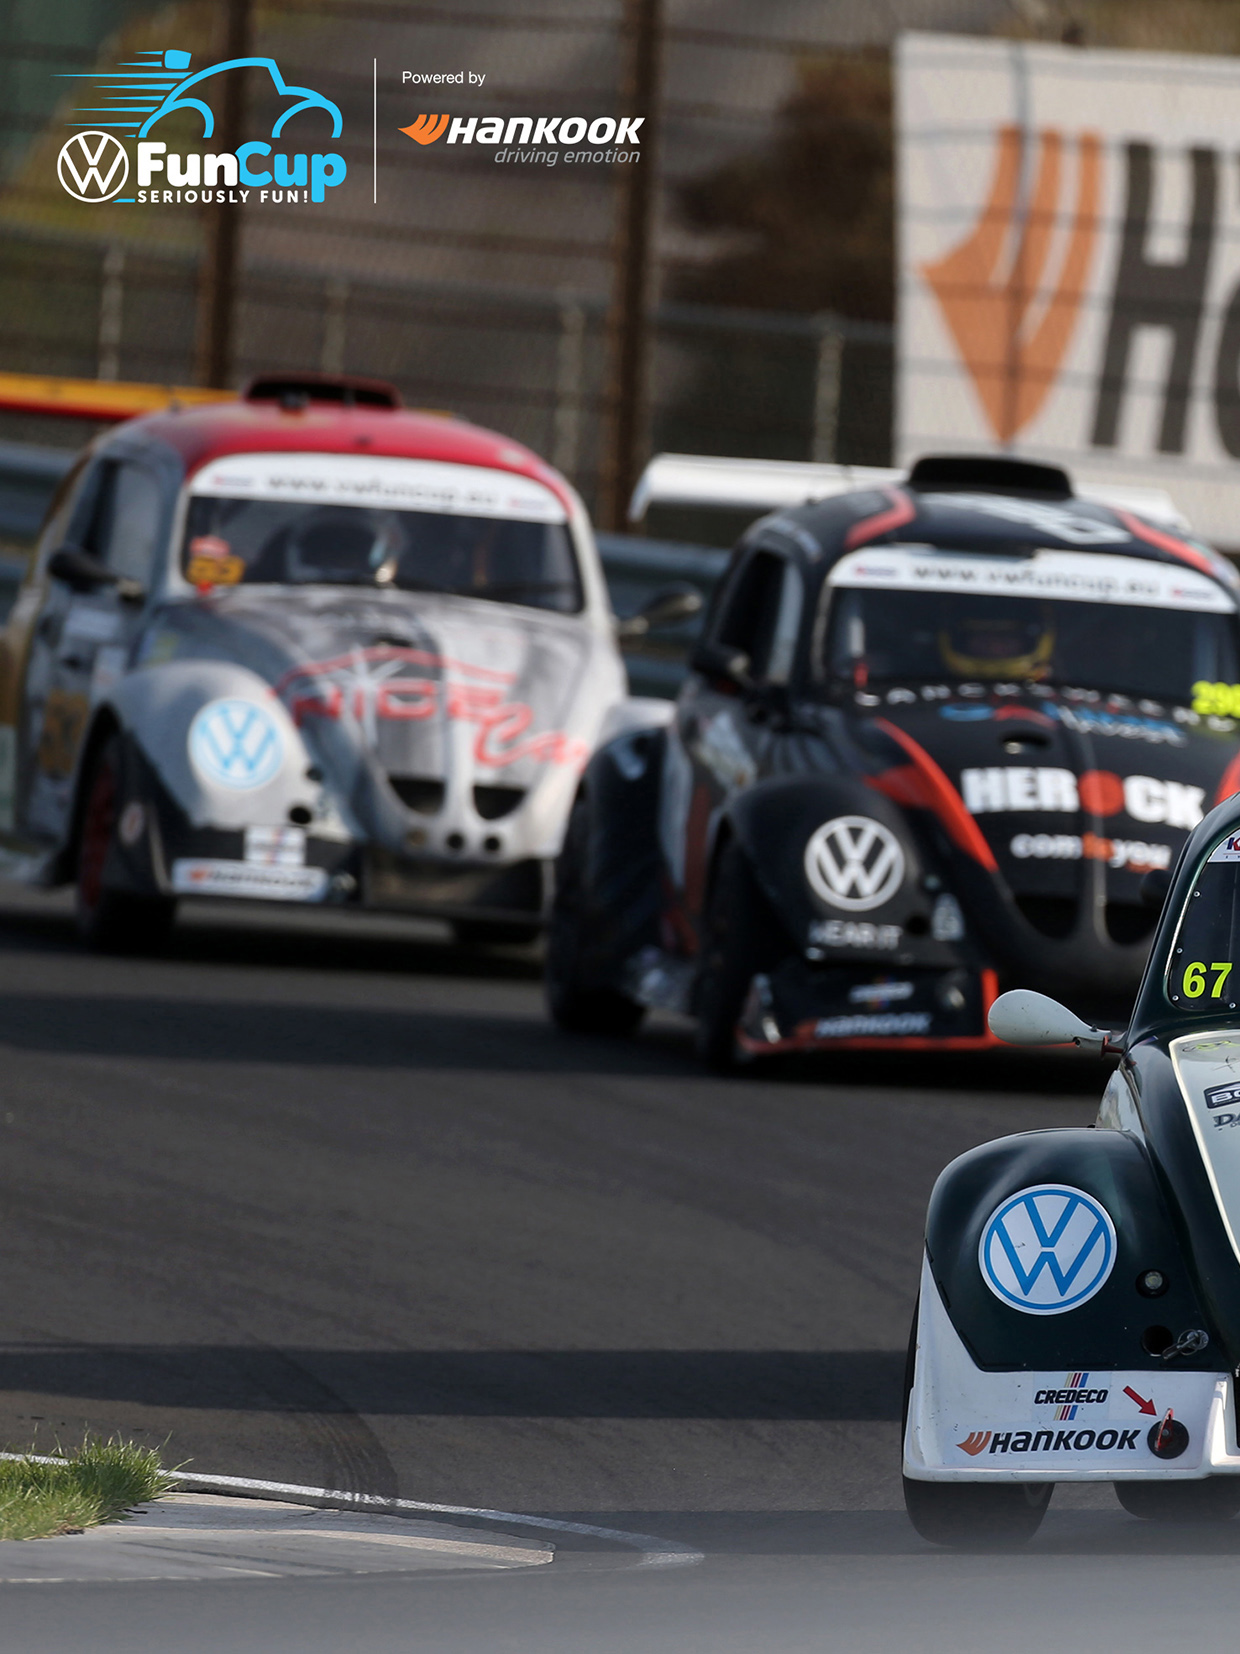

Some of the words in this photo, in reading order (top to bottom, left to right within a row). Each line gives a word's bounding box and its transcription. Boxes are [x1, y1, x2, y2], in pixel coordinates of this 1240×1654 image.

[960, 766, 1206, 832] HEROCK
[1182, 961, 1233, 998] 67
[1034, 1389, 1108, 1405] CREDECO
